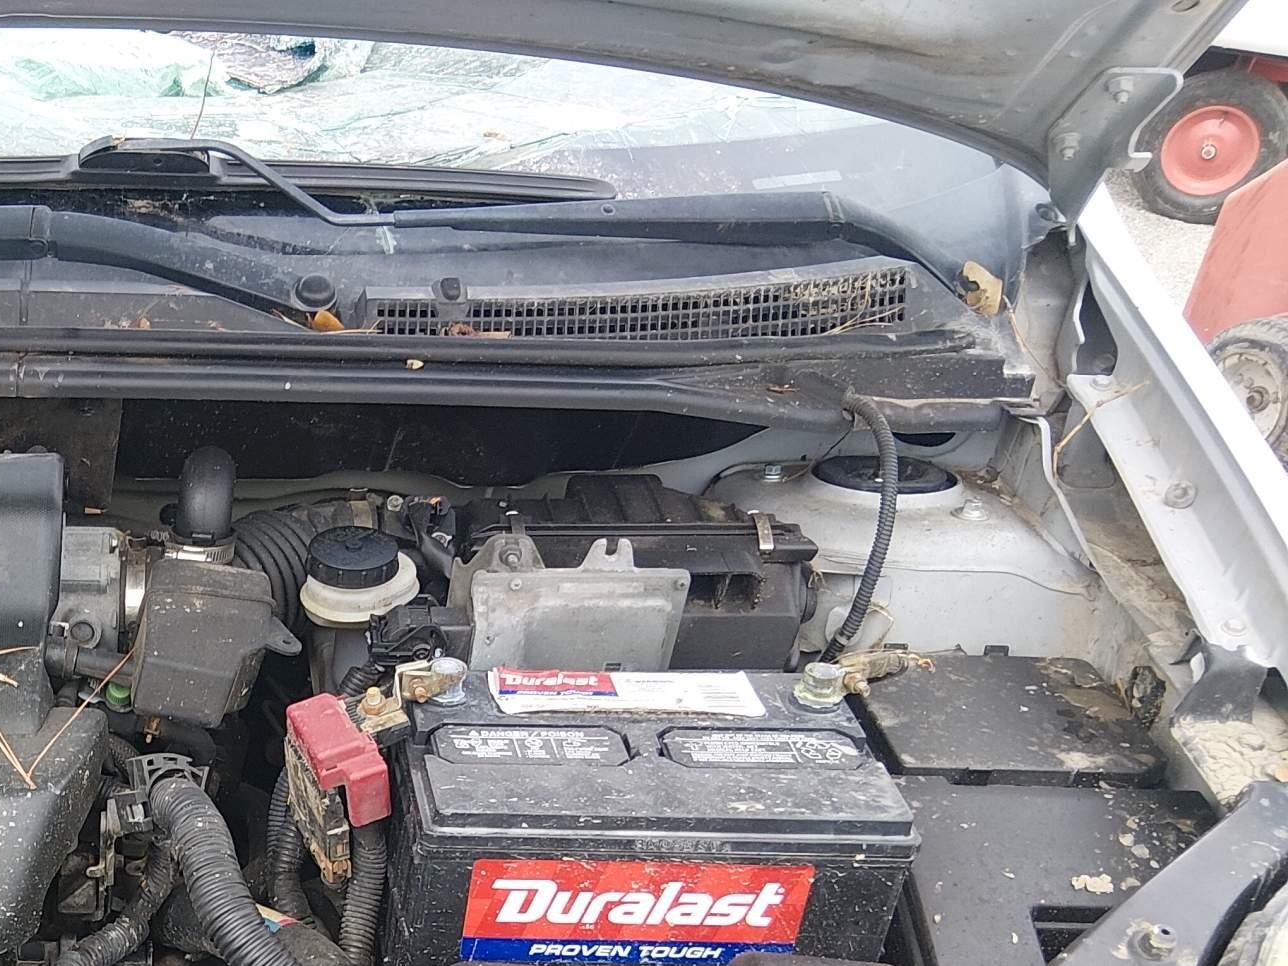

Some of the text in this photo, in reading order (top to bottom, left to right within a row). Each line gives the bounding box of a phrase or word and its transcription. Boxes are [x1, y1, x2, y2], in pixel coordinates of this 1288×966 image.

[500, 672, 599, 686] Duralast
[491, 878, 785, 927] Duralast
[528, 943, 723, 959] PROVEN TOUGH
